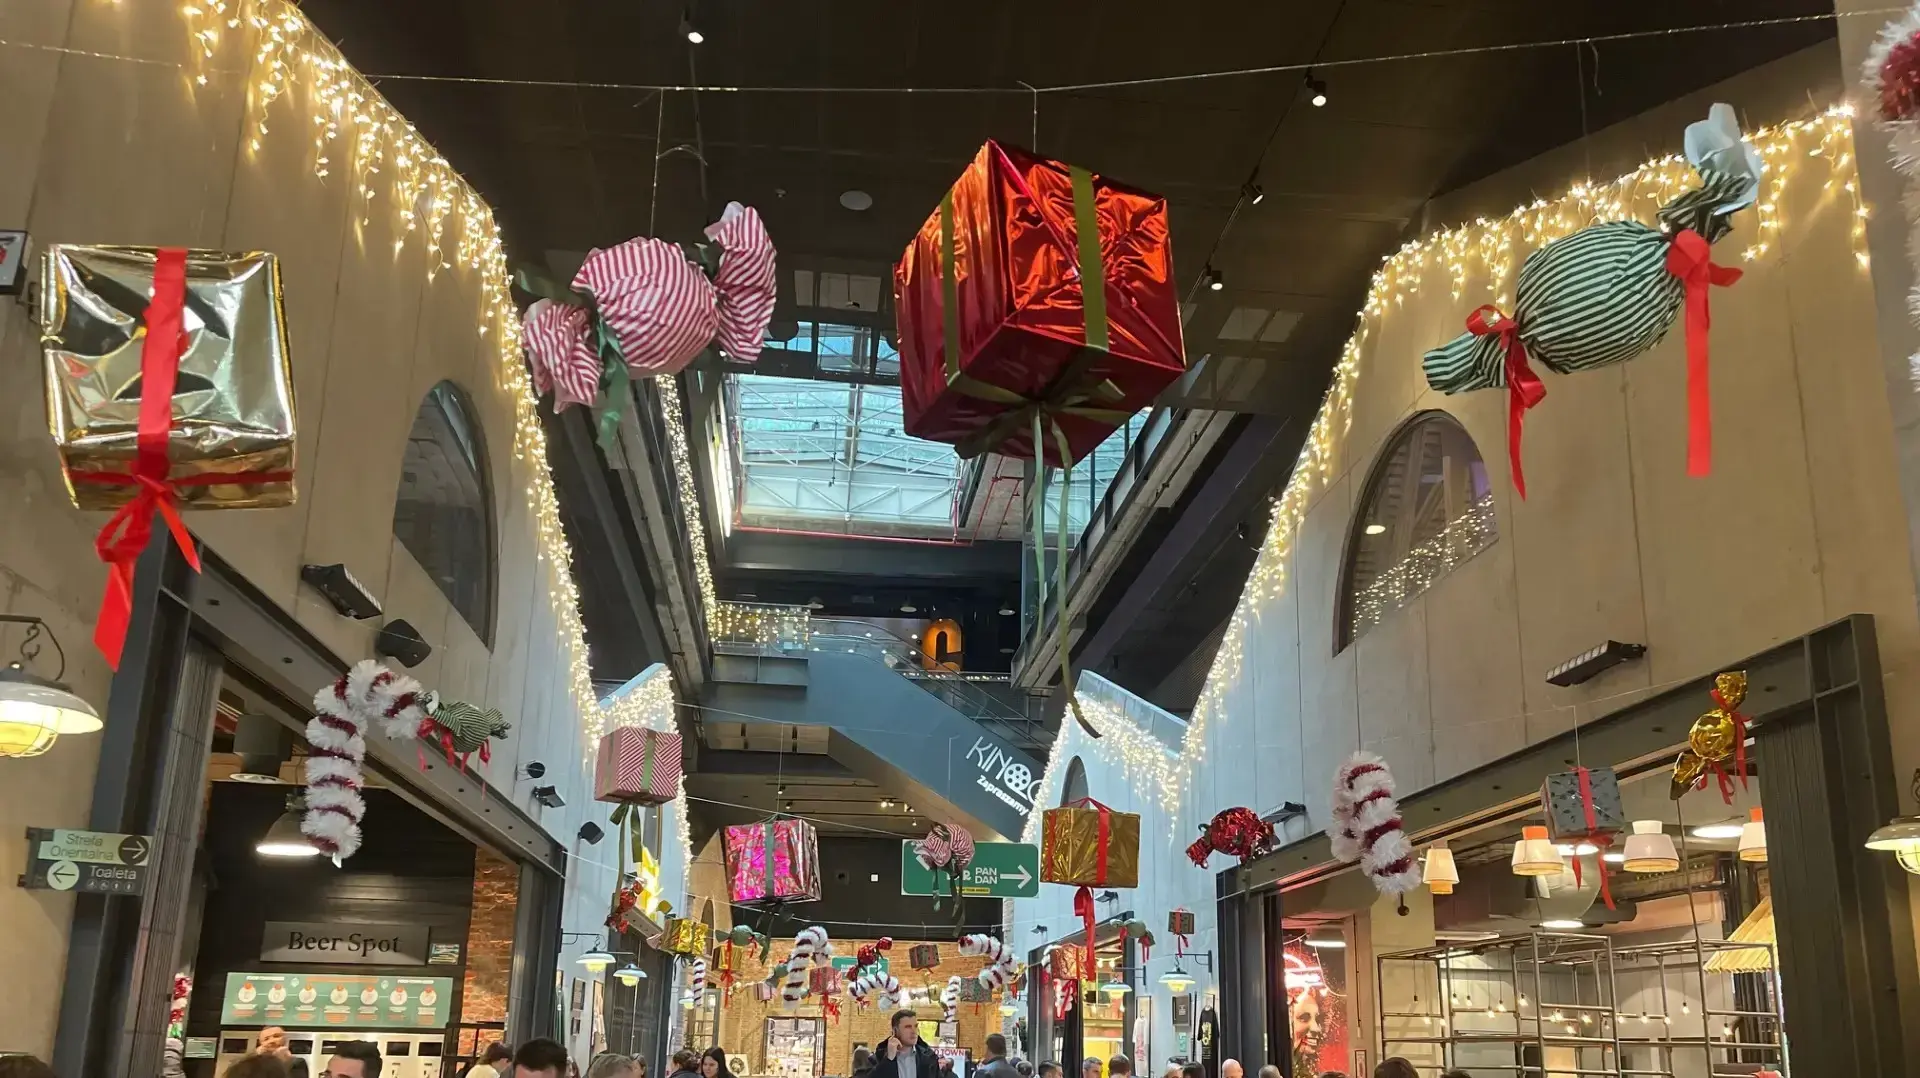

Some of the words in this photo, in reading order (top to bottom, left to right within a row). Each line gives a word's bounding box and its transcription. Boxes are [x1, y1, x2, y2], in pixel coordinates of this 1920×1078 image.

[976, 774, 1029, 817] Zapraszamy
[66, 833, 104, 847] Strefa
[50, 845, 114, 860] Orientalna
[90, 865, 137, 880] Toaleta
[975, 866, 997, 876] PAN
[975, 875, 998, 885] DAN
[288, 931, 343, 951] Beer
[347, 933, 402, 957] Spot
[940, 1048, 965, 1057] TOWN
